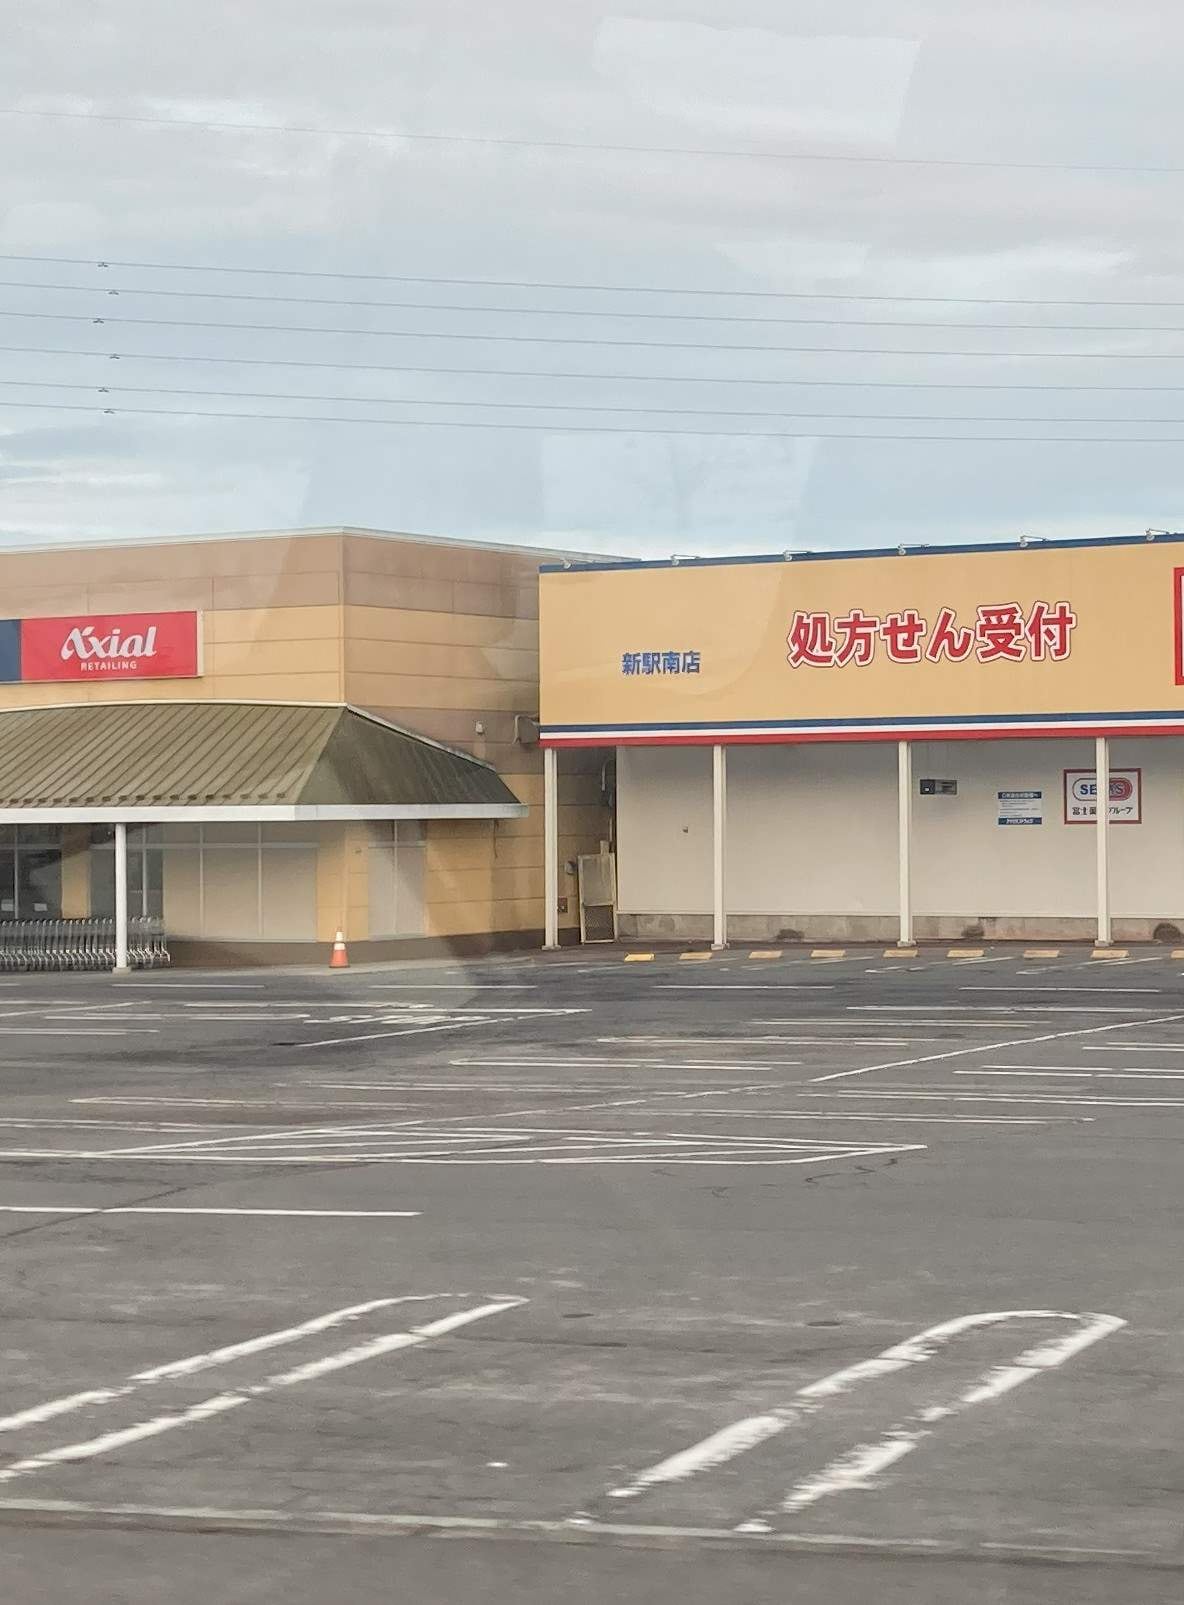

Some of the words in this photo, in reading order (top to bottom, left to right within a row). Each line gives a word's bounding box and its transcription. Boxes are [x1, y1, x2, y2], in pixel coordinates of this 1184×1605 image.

[60, 625, 158, 661] Axial
[788, 602, 1077, 668] 処方せん受付
[80, 660, 138, 672] RETAILING
[621, 651, 702, 676] 新駅南店
